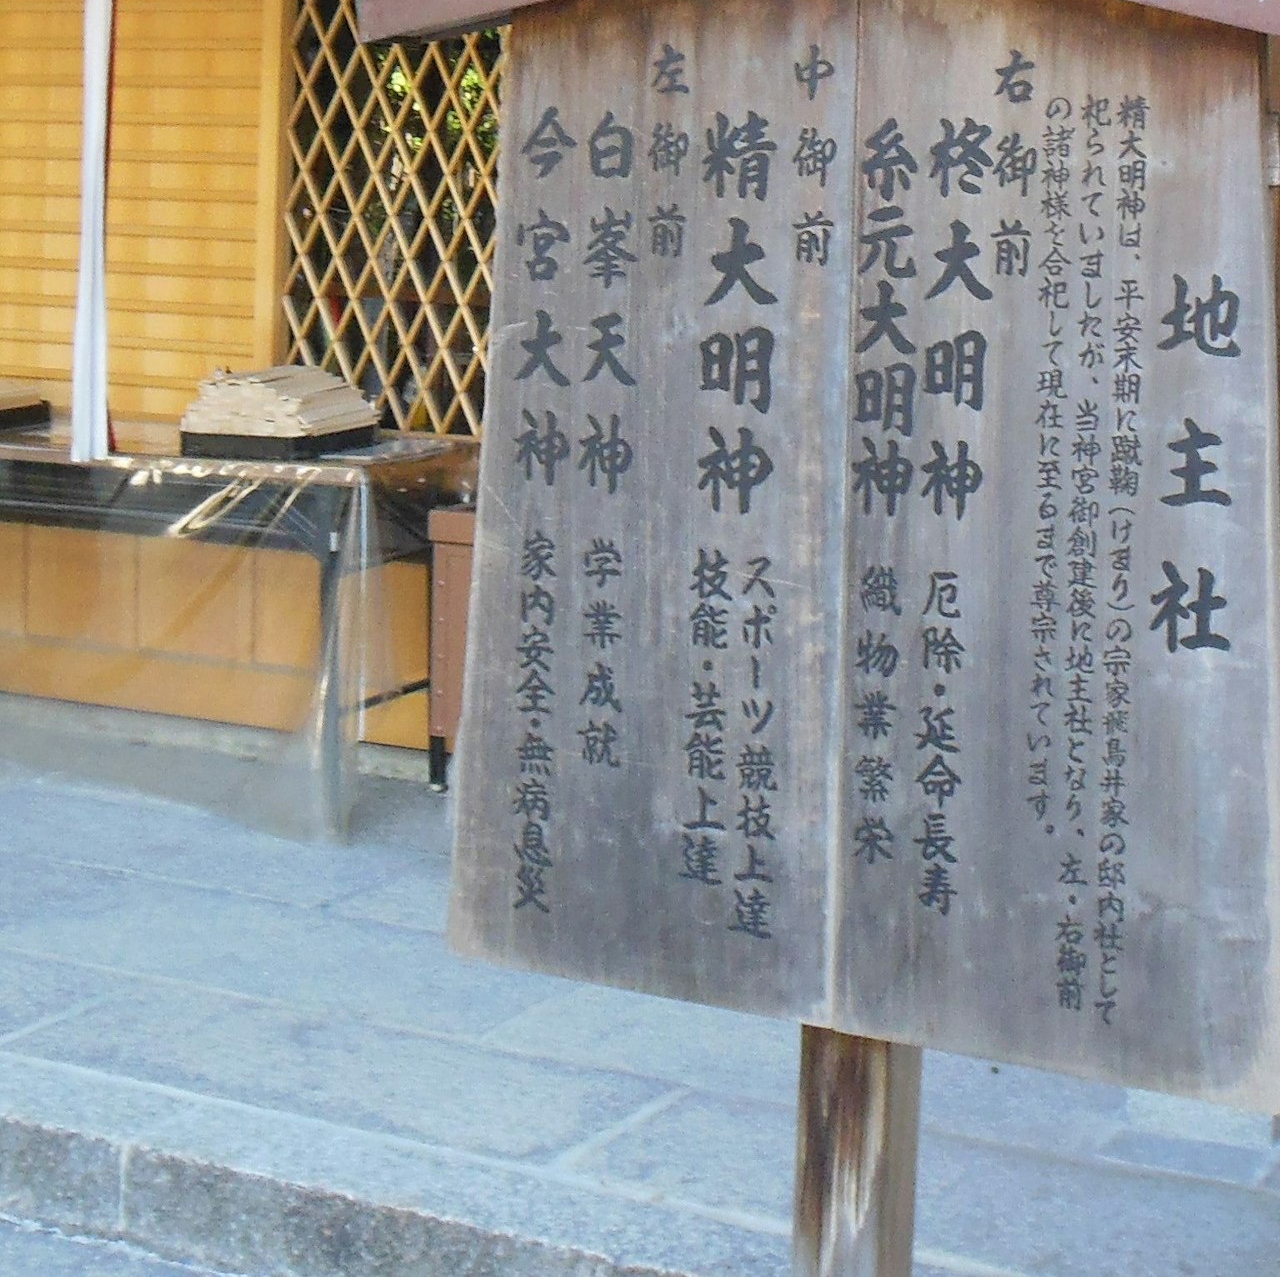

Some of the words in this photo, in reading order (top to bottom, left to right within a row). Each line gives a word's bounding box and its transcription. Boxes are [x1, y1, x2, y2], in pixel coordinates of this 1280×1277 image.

[513, 105, 578, 487] 今宮大神
[582, 110, 638, 495] 白峯天神
[647, 42, 690, 260] 左御前
[698, 110, 779, 515] 精大明神
[792, 44, 838, 267] 中御前
[853, 117, 919, 517] 糸元大明神
[924, 117, 994, 521] 柊大明神
[990, 49, 1038, 278] 右御前
[577, 536, 623, 770] 学業成就
[1150, 273, 1242, 654] 地主社
[513, 531, 557, 914] 家内安全・無病息災
[678, 547, 733, 886] 技能・芸能上達
[728, 555, 779, 941] スポーツ競技上達
[853, 567, 903, 865] 織物業繁栄
[913, 571, 966, 917] 厄除・延命長寿
